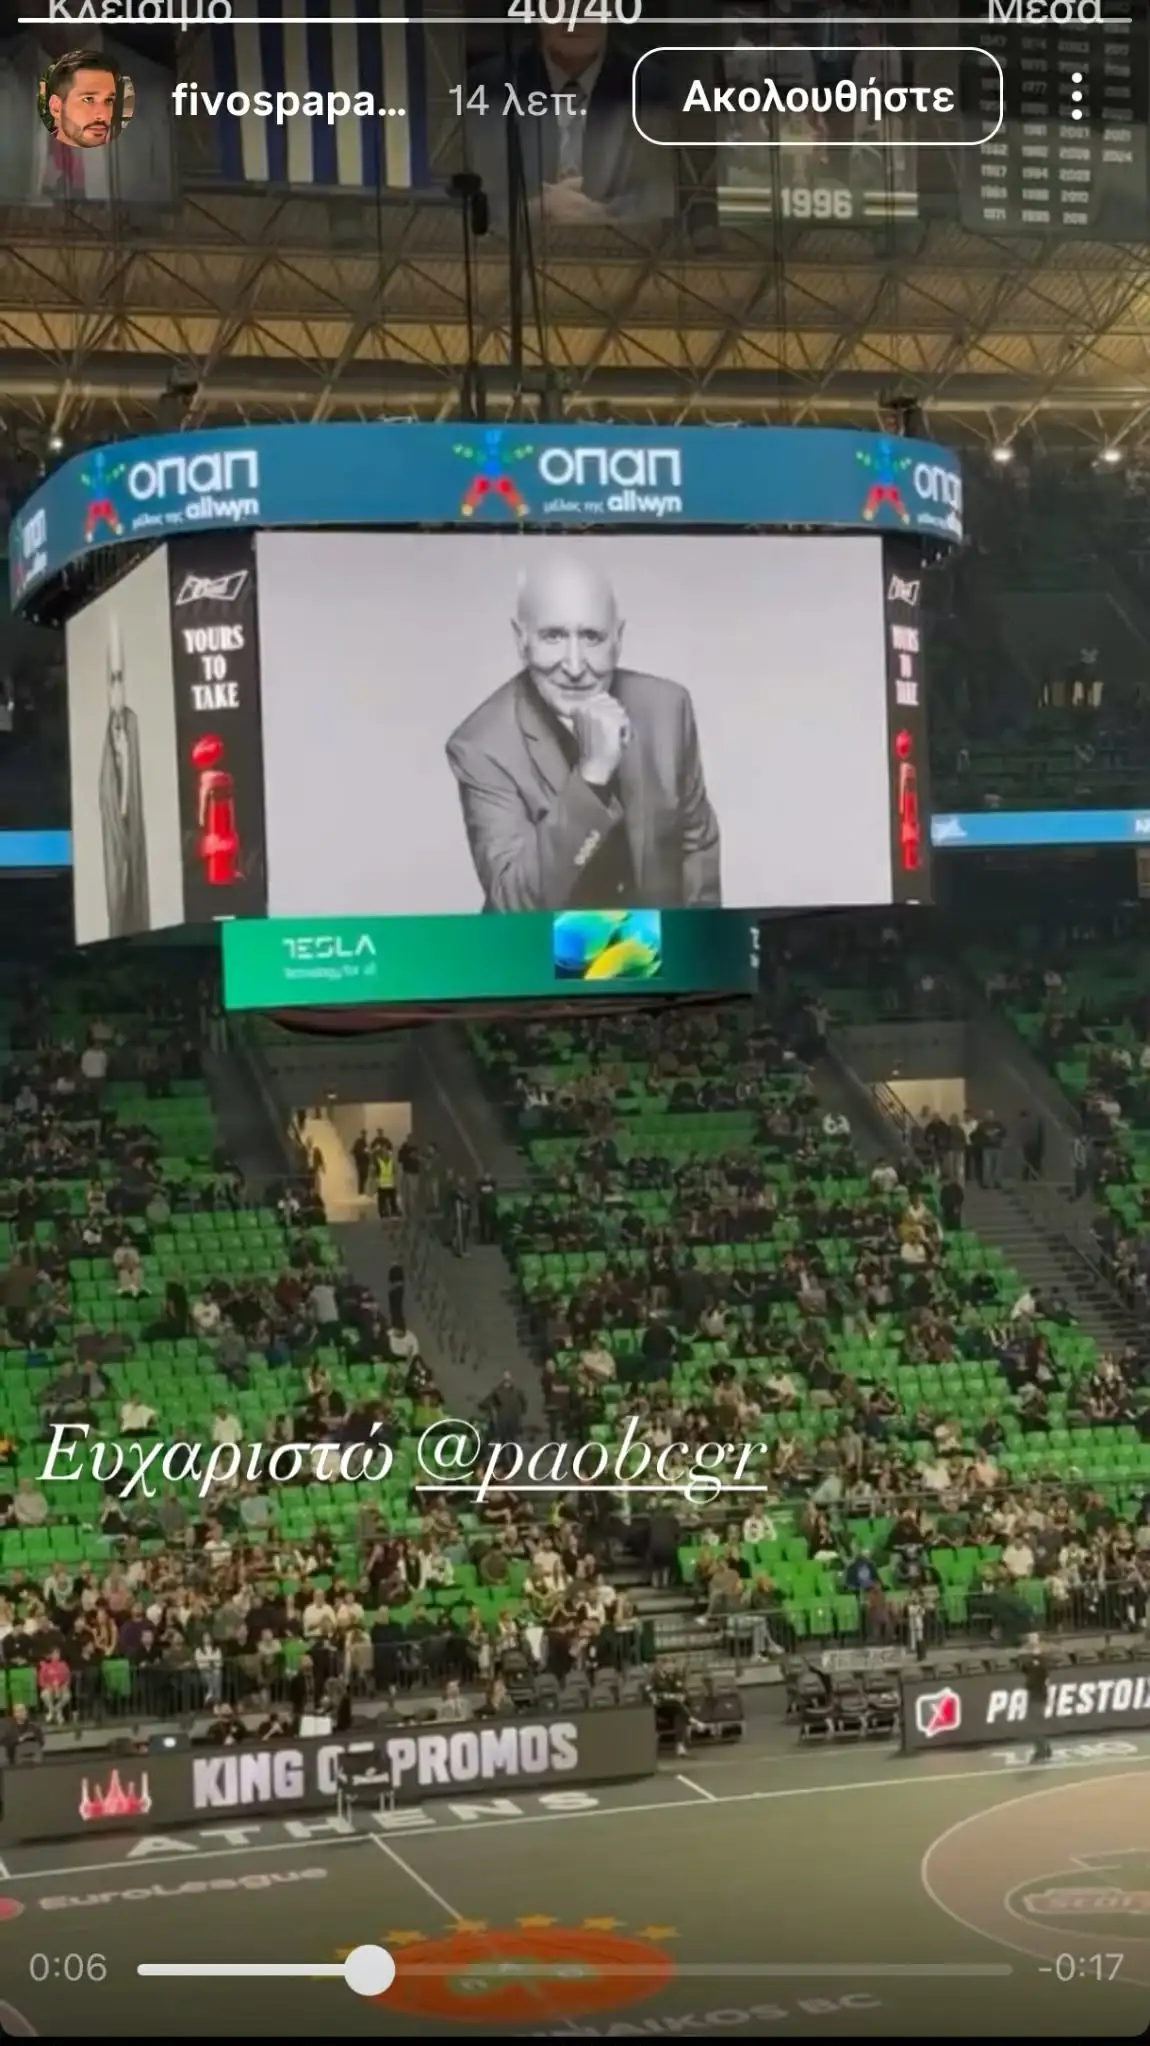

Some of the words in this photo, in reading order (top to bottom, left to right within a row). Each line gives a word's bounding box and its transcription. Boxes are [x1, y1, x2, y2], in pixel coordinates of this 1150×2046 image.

[781, 187, 853, 219] 1996
[185, 496, 259, 523] allwyn
[606, 488, 683, 518] allwyn
[183, 624, 245, 654] YOURS
[201, 654, 227, 681] TO
[191, 682, 240, 711] TAKE
[282, 934, 377, 960] TESLA
[986, 1676, 1150, 1724] PAESTOI
[193, 1750, 304, 1809] KING
[386, 1722, 578, 1787] PROMOS
[127, 1791, 600, 1858] ATHENS
